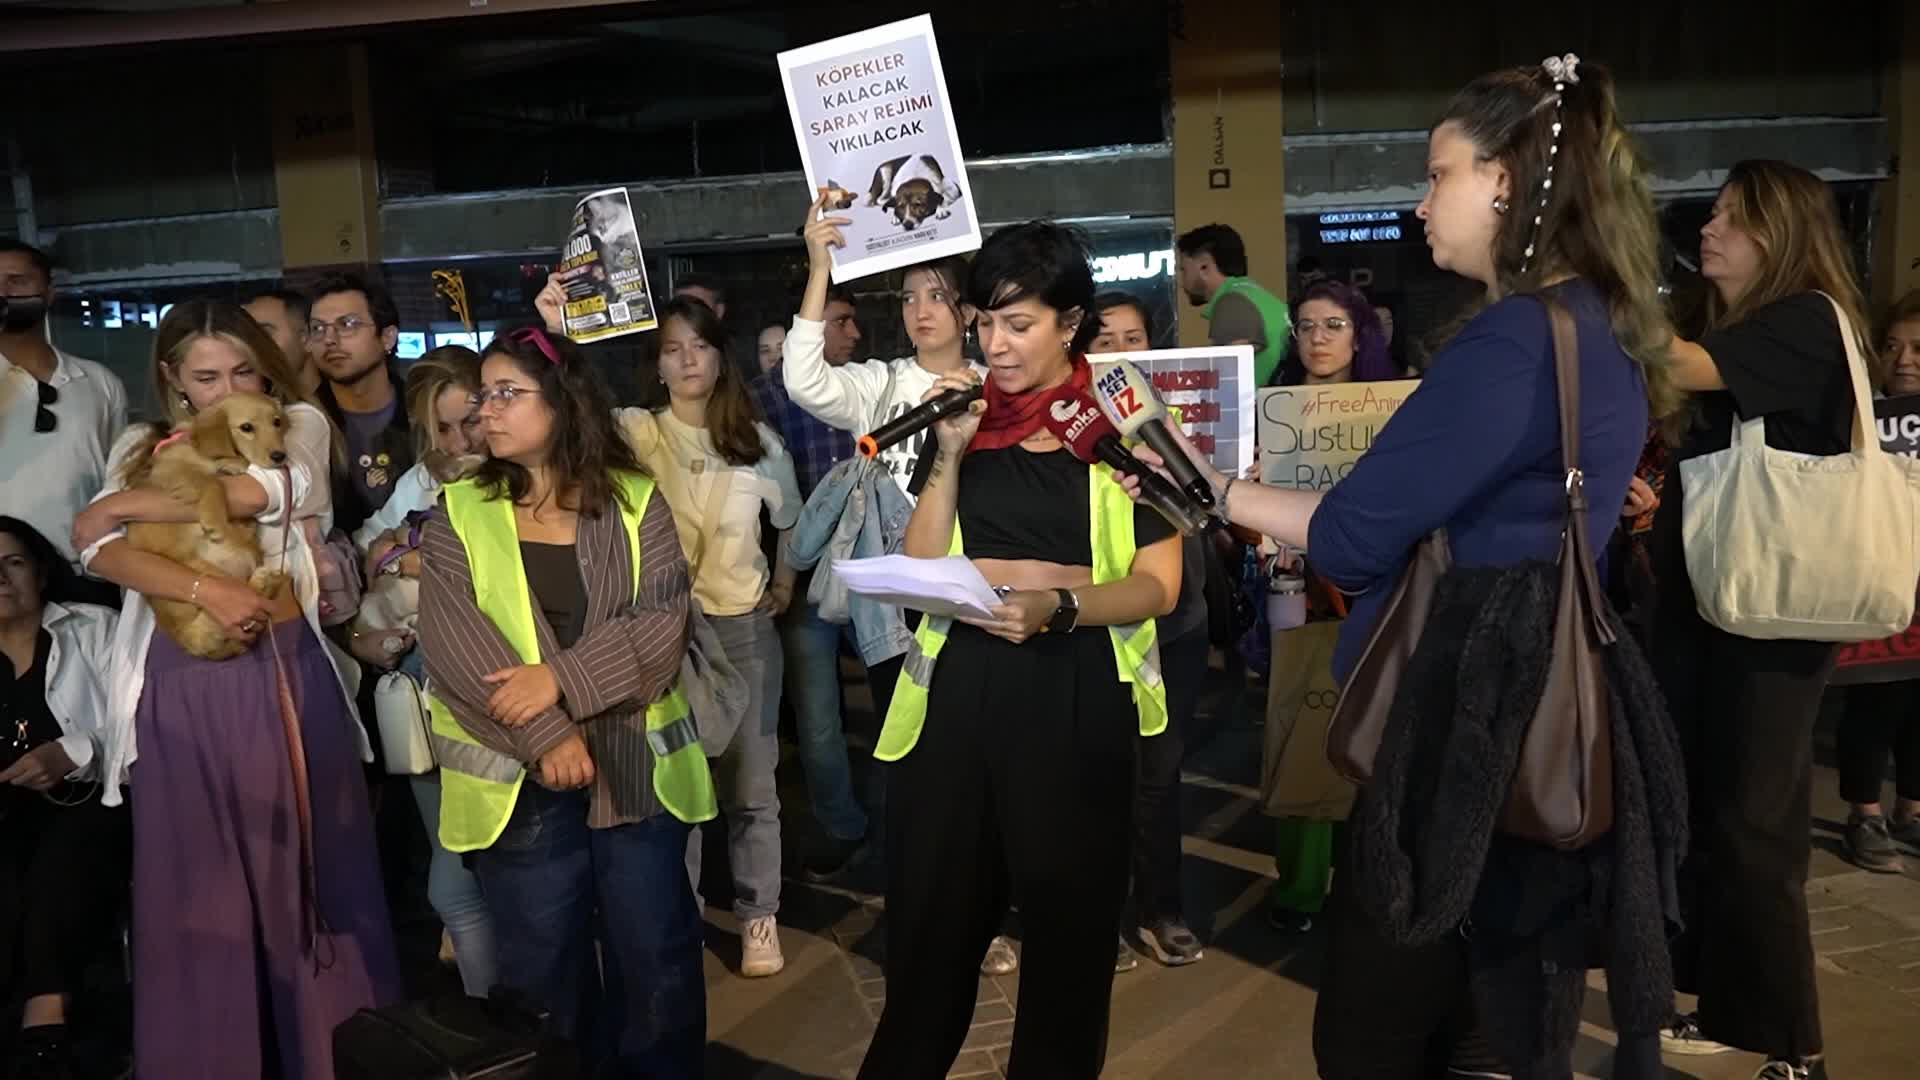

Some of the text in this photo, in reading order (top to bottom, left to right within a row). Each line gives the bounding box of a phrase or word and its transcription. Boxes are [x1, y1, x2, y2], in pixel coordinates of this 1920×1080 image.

[816, 53, 904, 87] KÖPEKLER
[823, 75, 909, 109] KALACAK
[811, 90, 933, 136] SARAY REJİMİ
[829, 119, 924, 154] YIKILACAK
[1097, 366, 1125, 391] MAN
[1106, 375, 1128, 397] SET
[1065, 407, 1100, 441] anka
